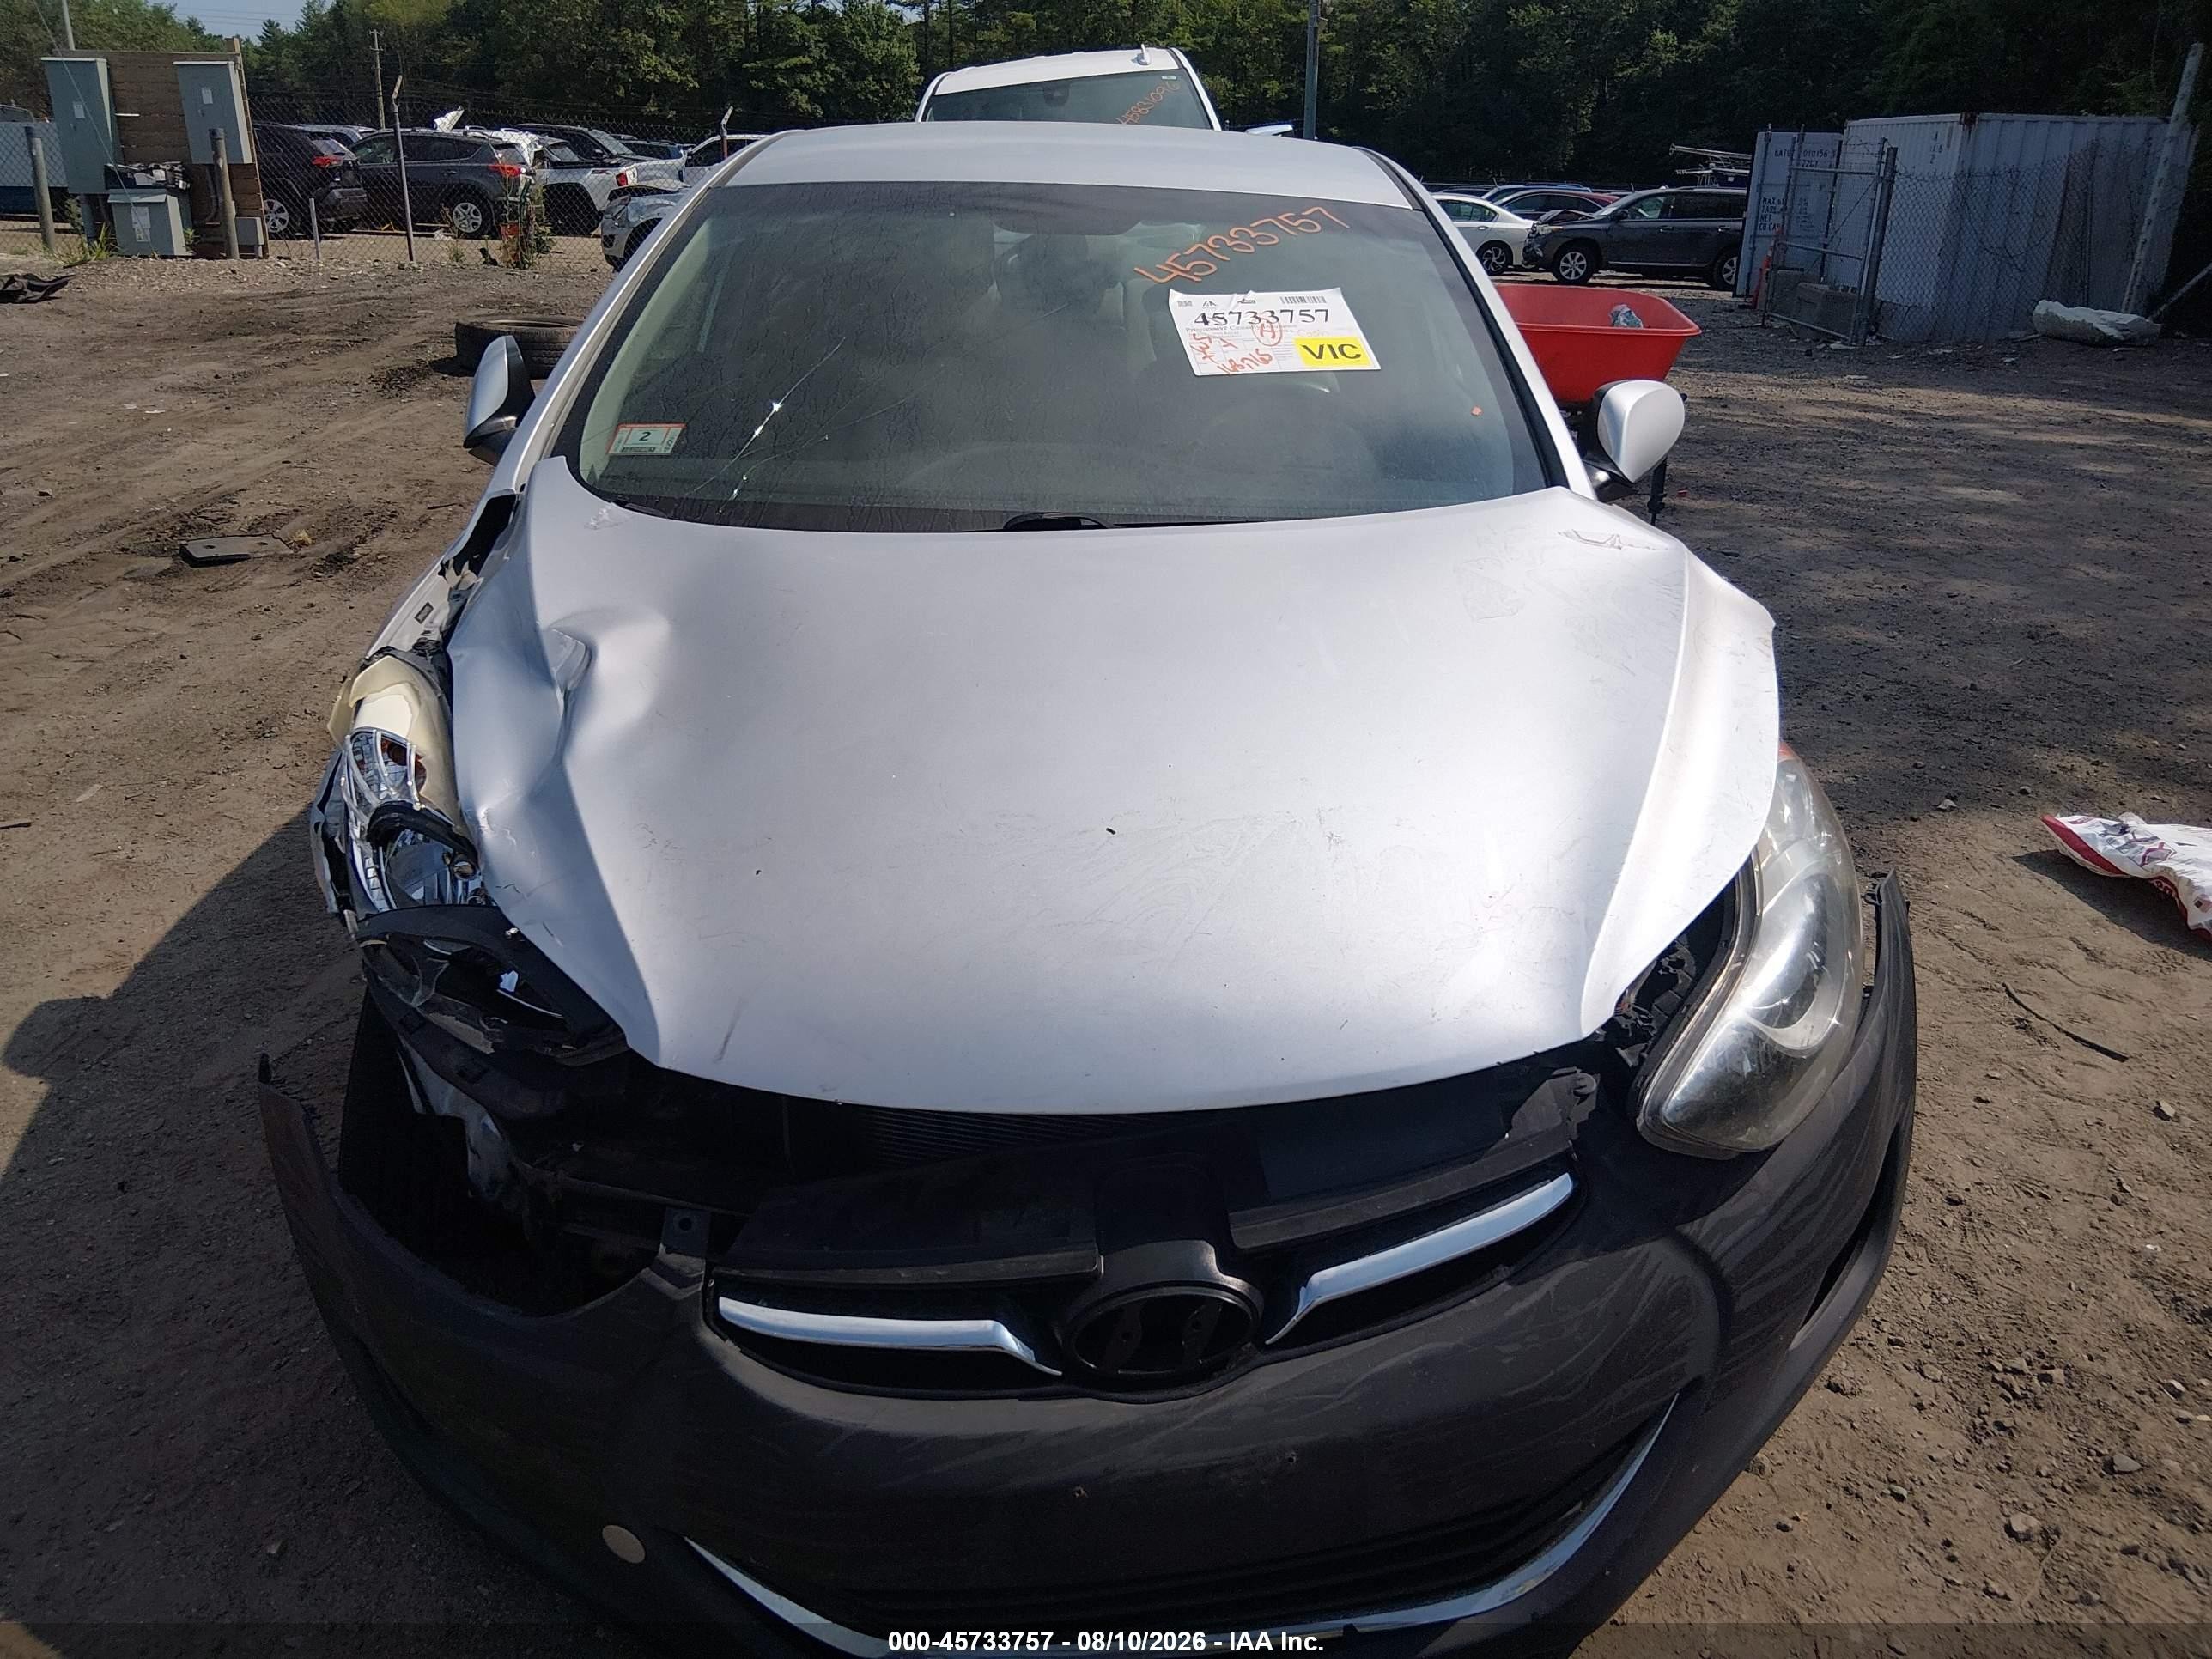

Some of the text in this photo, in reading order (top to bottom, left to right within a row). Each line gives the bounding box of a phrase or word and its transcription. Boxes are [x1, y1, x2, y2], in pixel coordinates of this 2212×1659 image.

[1133, 206, 1351, 284] 45733757
[1194, 309, 1329, 325] 45733757
[1300, 343, 1362, 360] VIC
